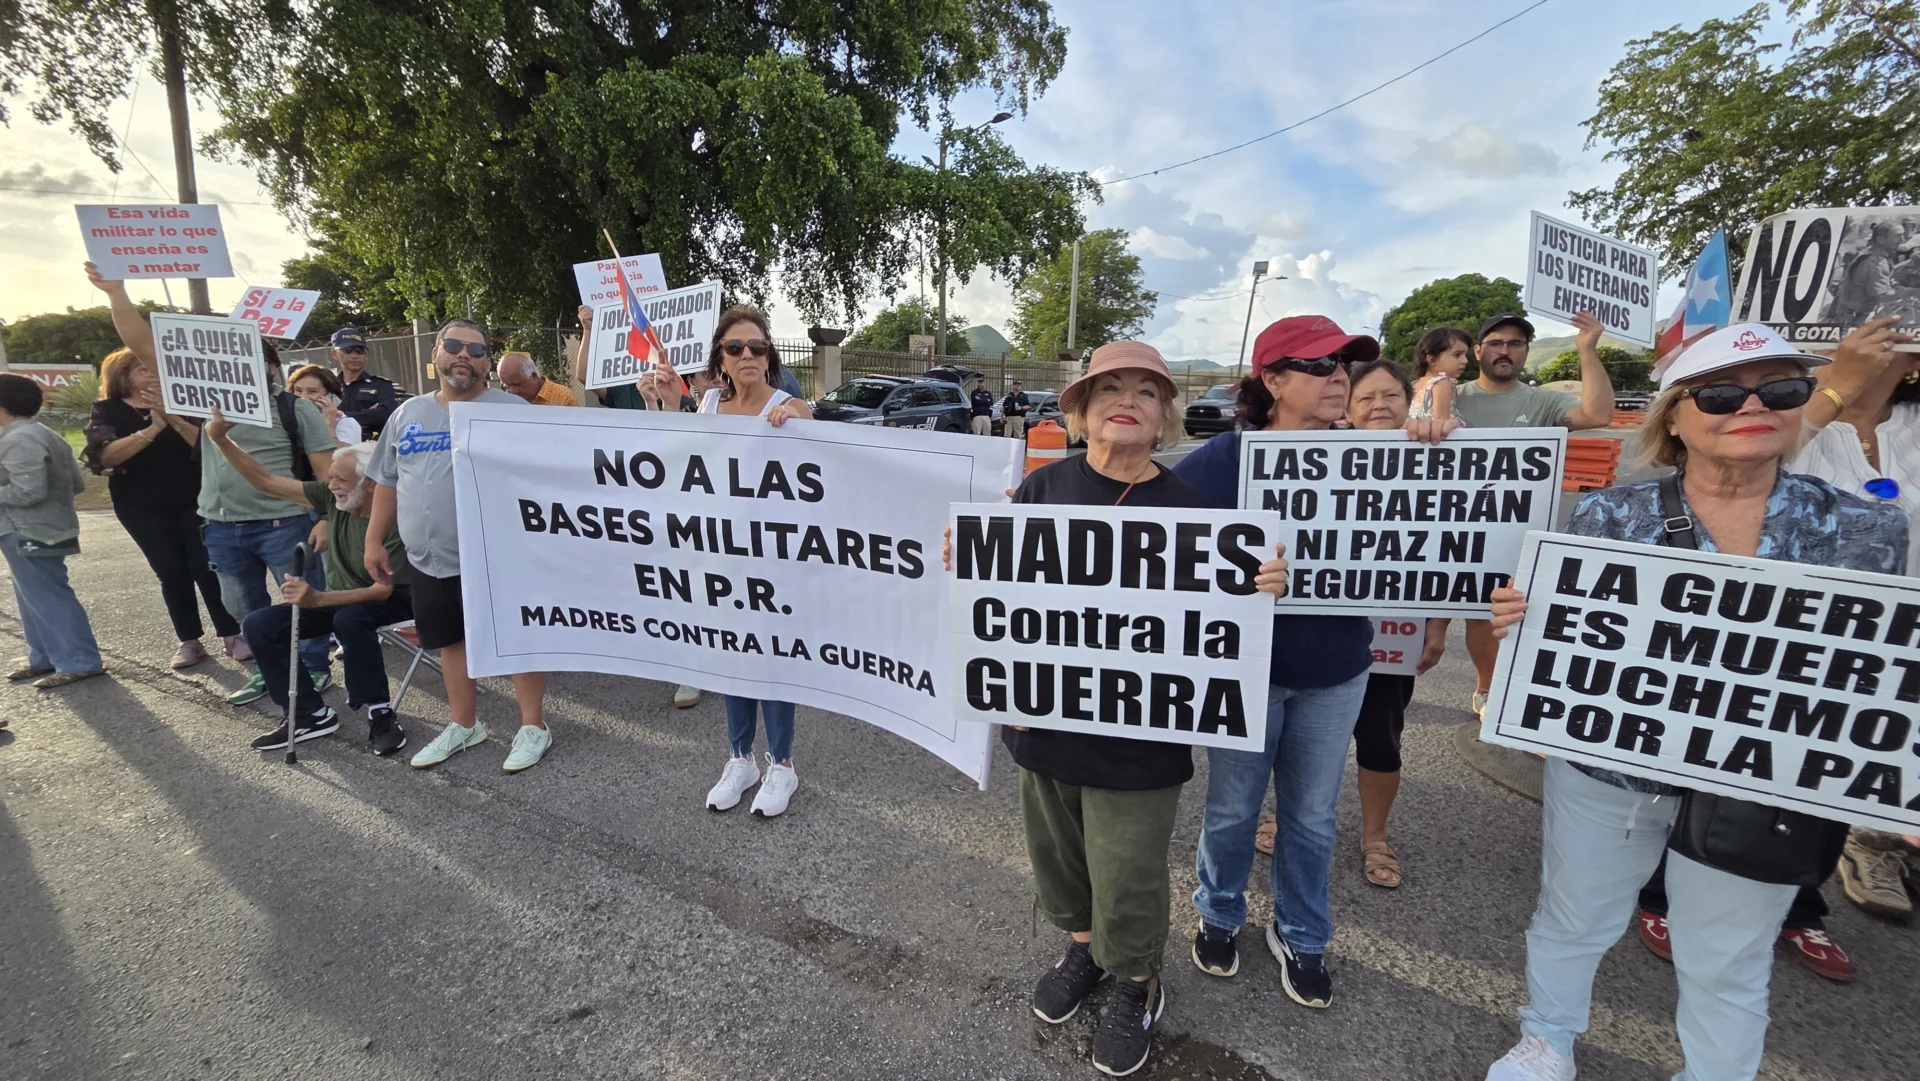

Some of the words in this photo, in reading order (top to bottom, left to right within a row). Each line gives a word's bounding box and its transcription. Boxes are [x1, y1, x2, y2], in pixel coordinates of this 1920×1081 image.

[107, 207, 144, 219] Esa
[148, 207, 190, 219] vida
[91, 225, 155, 238] militar
[160, 225, 177, 236] lo
[182, 227, 218, 239] que
[111, 243, 182, 255] enseña
[186, 245, 209, 254] es
[128, 264, 140, 273] a
[144, 262, 201, 273] matar
[597, 262, 617, 271] Paz
[1542, 223, 1607, 266] JUSTICIA
[1610, 246, 1648, 280] PARA
[600, 272, 643, 285] Jusia
[1537, 250, 1564, 281] LOS
[1567, 260, 1650, 308] VETERANOS
[1738, 217, 1832, 323] NO
[272, 299, 286, 310] a
[287, 297, 305, 312] la
[606, 284, 659, 298] qumos
[1553, 285, 1630, 331] ENFERMOS
[601, 309, 631, 331] JOVE
[676, 319, 695, 341] AL
[1794, 327, 1840, 341] GOTA
[162, 327, 189, 351] ¿A
[192, 328, 253, 357] QUIÉN
[165, 355, 256, 386] MATARÍA
[601, 342, 703, 379] RECLUDOR
[172, 383, 259, 415] CRISTO?
[398, 431, 452, 455] Sant
[593, 448, 666, 490] NO
[680, 454, 715, 495] A
[727, 457, 826, 503] LAS
[1253, 447, 1328, 481] LAS
[1341, 446, 1552, 481] GUERRAS
[1262, 488, 1318, 521] NO
[1330, 483, 1533, 523] TRAERÁN
[518, 498, 653, 545] BASES
[666, 513, 925, 580] MILITARES
[956, 515, 1266, 596] MADRES
[1295, 529, 1338, 561] NI
[1349, 529, 1430, 562] PAZ
[1439, 531, 1487, 563] NI
[633, 563, 692, 603] EN
[705, 572, 793, 615] P.R.
[1555, 556, 1638, 606] LA
[1660, 572, 1920, 649] GUERR
[972, 597, 1165, 654] Contra
[1183, 610, 1240, 660] la
[1381, 620, 1417, 636] no
[521, 605, 637, 635] MADRES
[643, 617, 764, 656] CONTRA
[771, 635, 812, 662] LA
[819, 643, 937, 698] GUERRA
[1372, 649, 1404, 664] az
[1542, 603, 1629, 651] ES
[1645, 620, 1920, 704] MUERT
[966, 657, 1248, 738] GUERRA
[1530, 649, 1920, 758] LUCHEMO
[1520, 693, 1666, 757] POR
[1683, 726, 1773, 781] LA
[1796, 748, 1920, 812] PA
